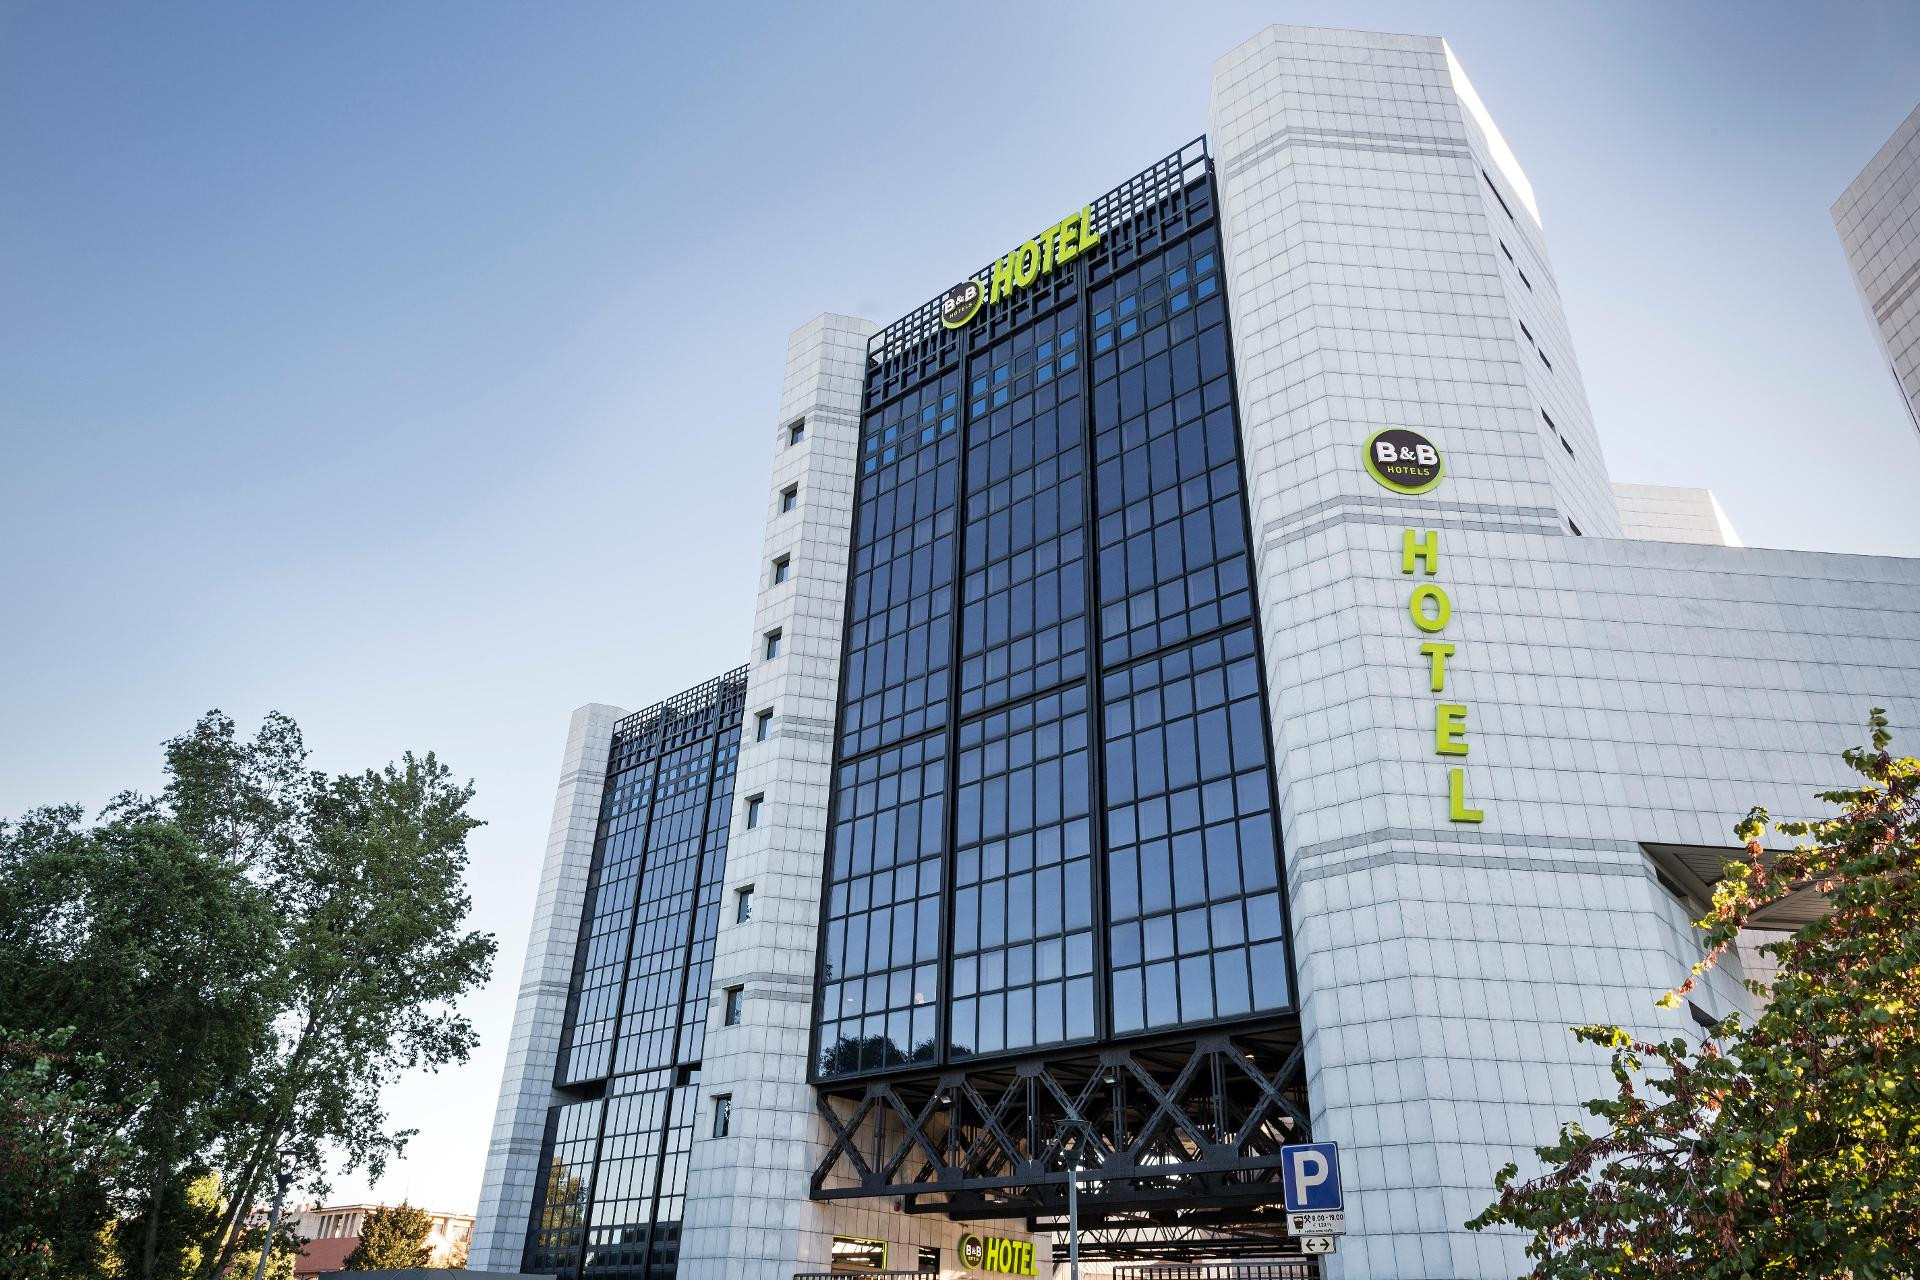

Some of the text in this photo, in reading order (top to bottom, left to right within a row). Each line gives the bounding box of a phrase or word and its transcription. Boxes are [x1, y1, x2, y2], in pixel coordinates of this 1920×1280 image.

[989, 205, 1100, 304] HOTEL
[944, 286, 977, 314] B&B
[949, 303, 972, 318] HOTELS
[1375, 441, 1438, 466] B&B
[1387, 466, 1430, 476] HOTELS
[1401, 528, 1484, 823] HOTEL
[1293, 1150, 1328, 1205] P
[966, 1244, 982, 1256] B&B
[986, 1237, 1039, 1275] HOTEL
